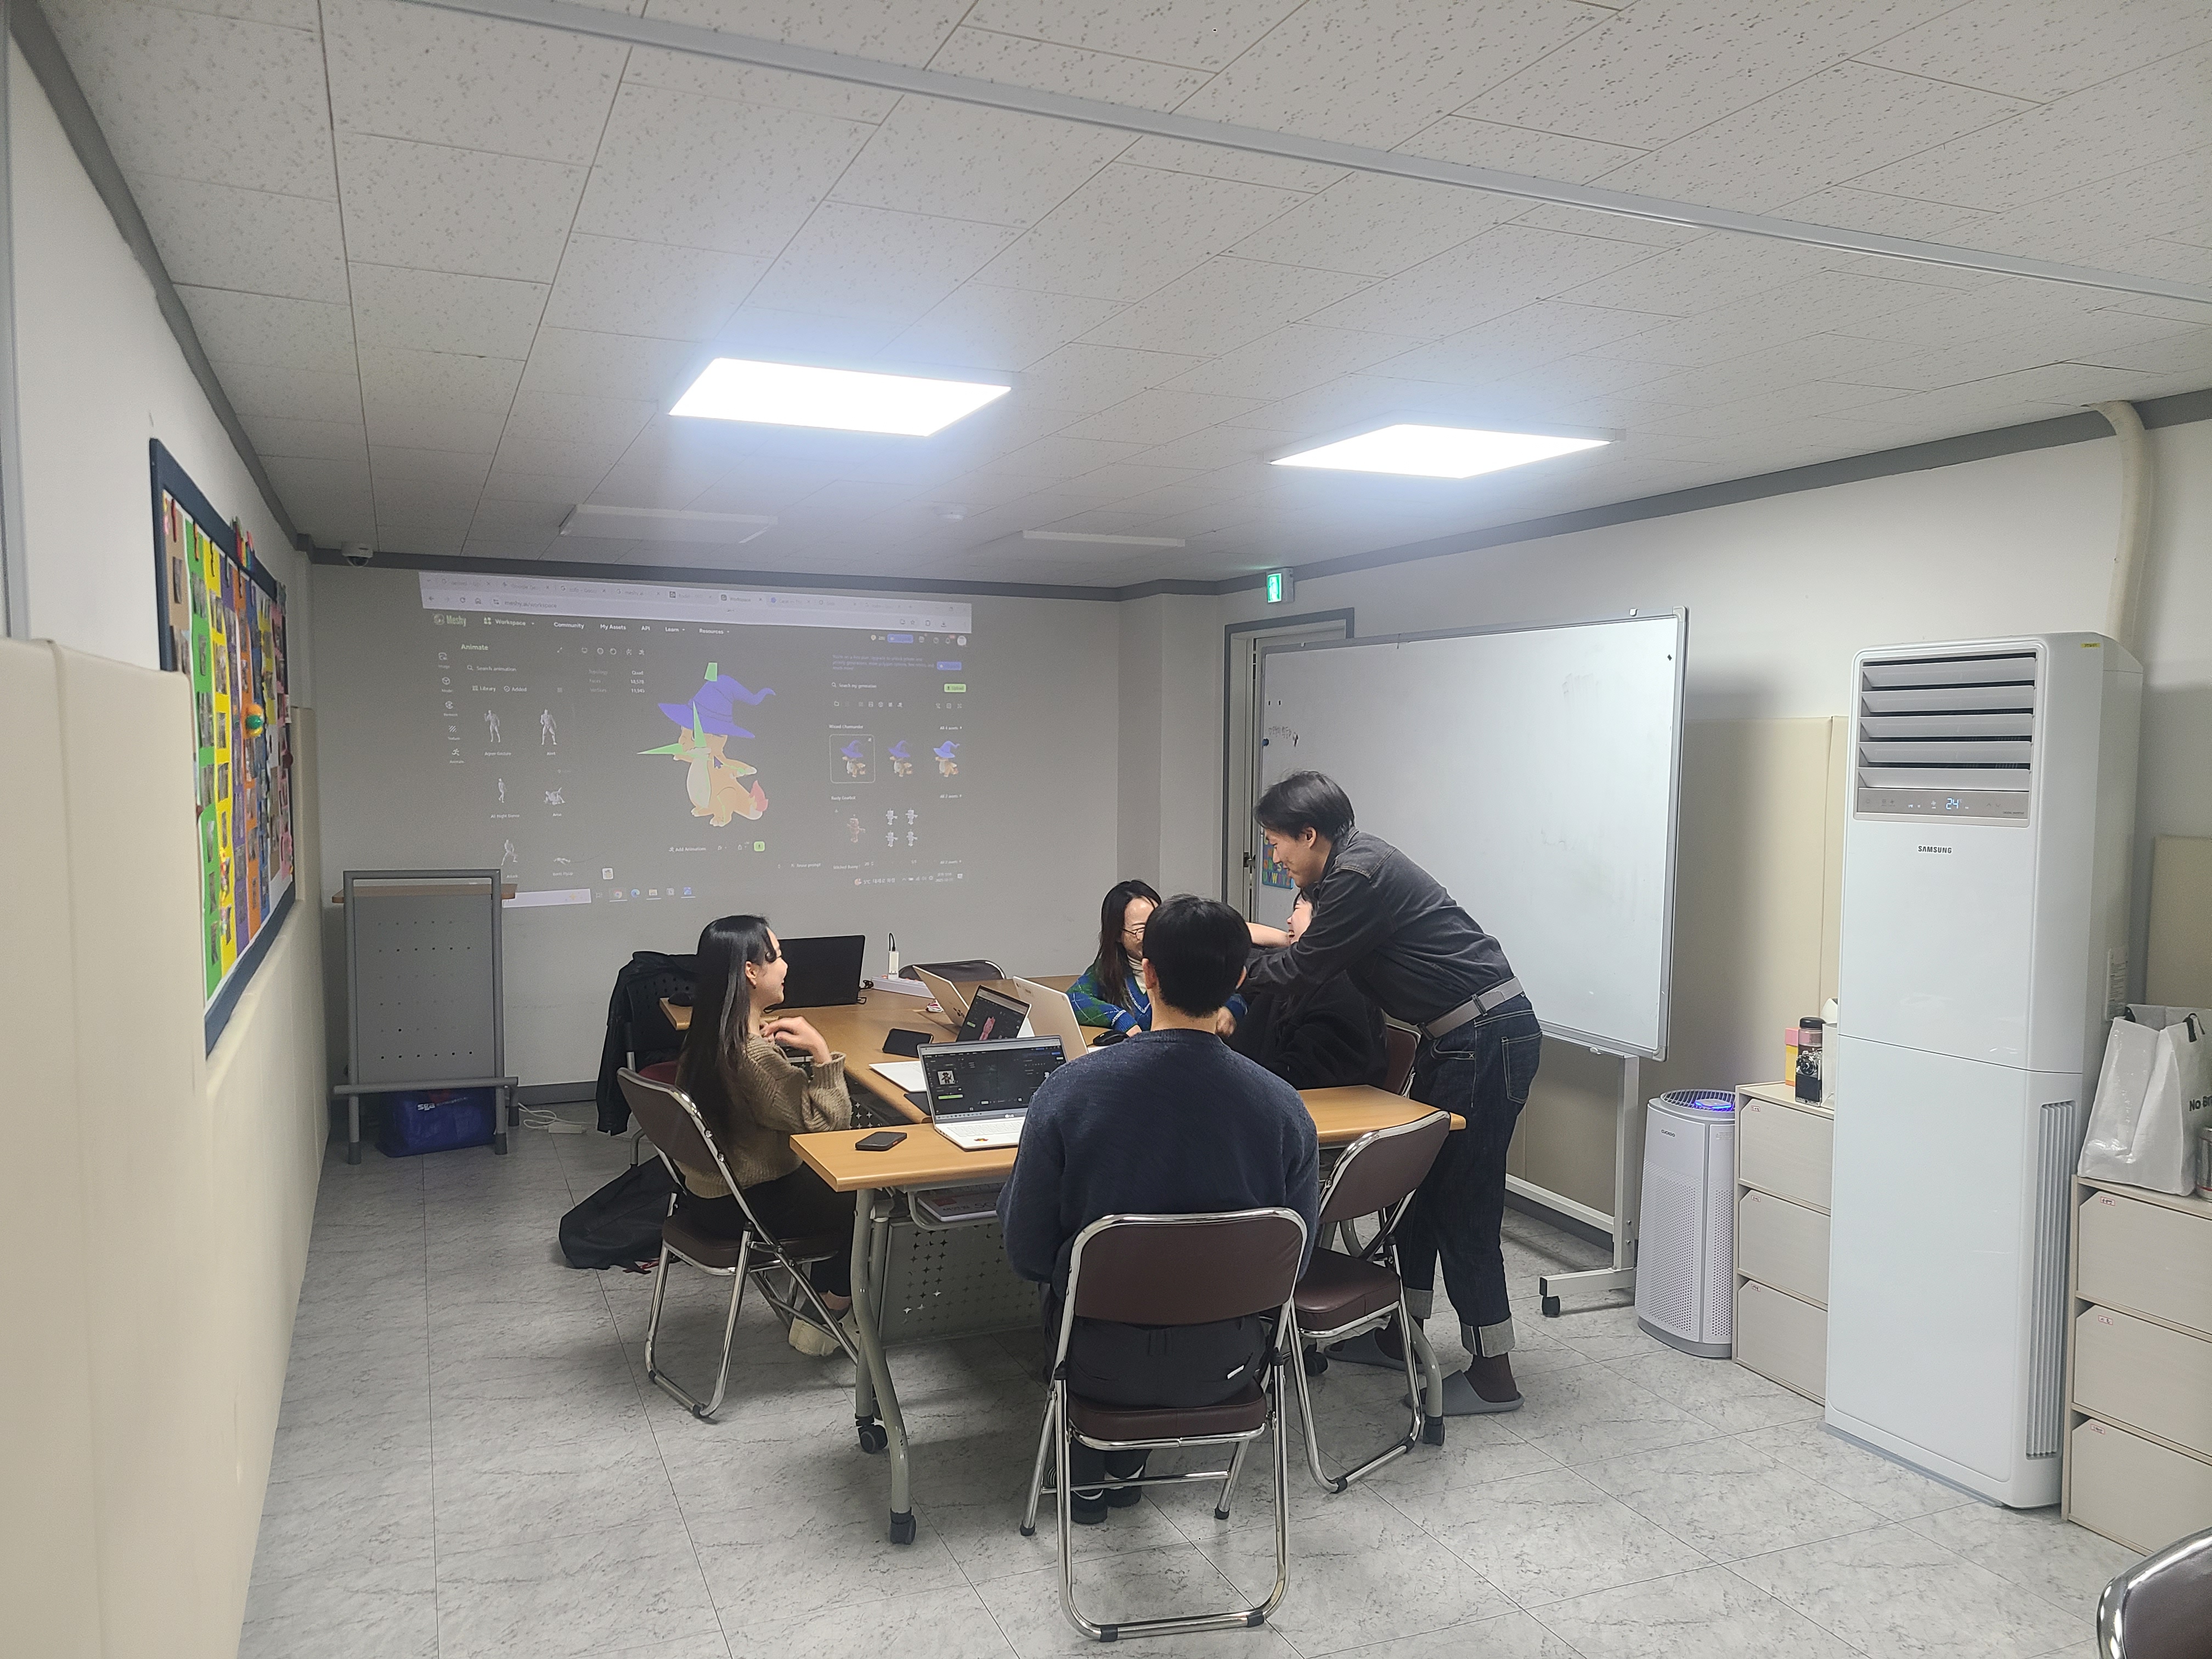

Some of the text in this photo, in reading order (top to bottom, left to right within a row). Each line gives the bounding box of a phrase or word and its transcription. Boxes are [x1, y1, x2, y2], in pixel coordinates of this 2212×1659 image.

[447, 615, 466, 627] Meshy
[495, 618, 526, 627] Workspace
[1918, 845, 1952, 854] SAMSUNG
[417, 1103, 436, 1111] sga
[1661, 1129, 1675, 1137] CUCKOO
